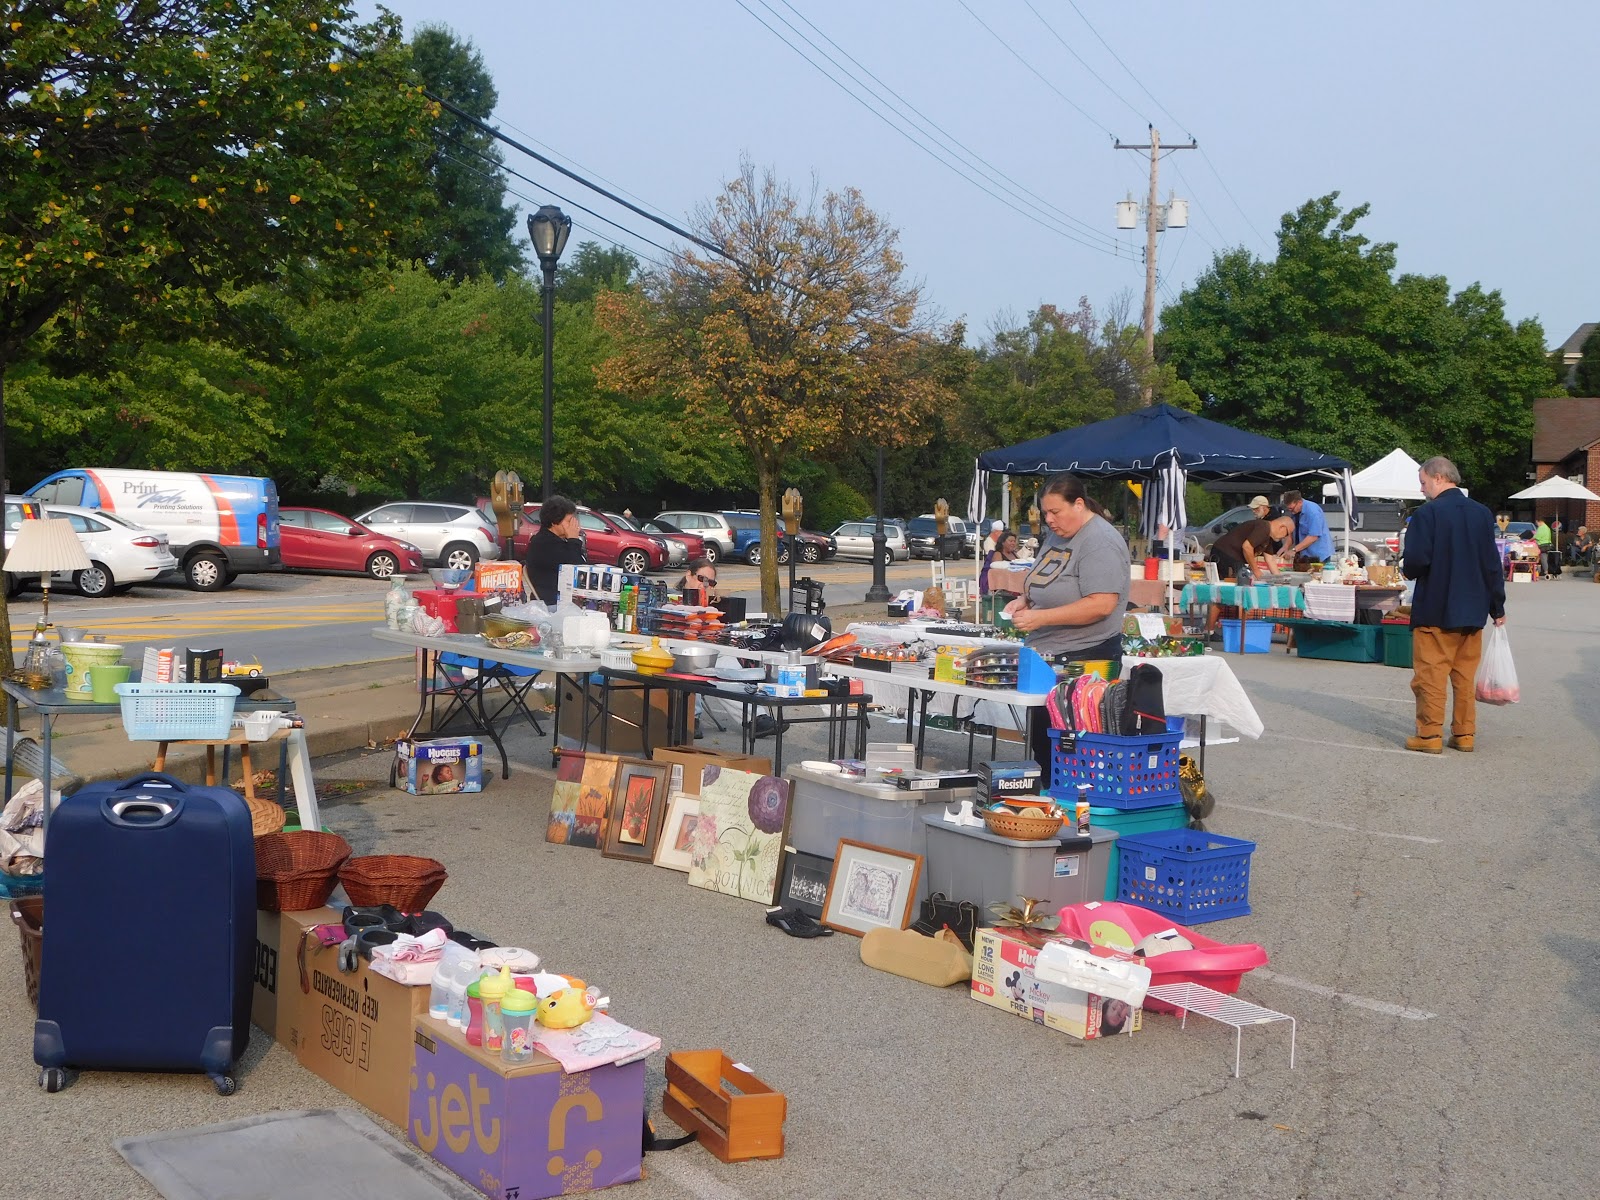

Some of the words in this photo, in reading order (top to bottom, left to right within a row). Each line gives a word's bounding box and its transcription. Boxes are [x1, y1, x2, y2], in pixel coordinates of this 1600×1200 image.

[122, 481, 158, 494] Print
[153, 503, 176, 511] Printing
[176, 503, 203, 511] Solutions
[480, 570, 520, 589] WHEATIES
[998, 778, 1034, 790] ResistAll
[982, 945, 994, 959] 12
[977, 962, 995, 974] LONG
[312, 968, 360, 1014] REFRIGERATED
[361, 993, 379, 1023] KEEP
[1010, 1000, 1029, 1015] FREE
[1087, 994, 1098, 1037] HUGGIES
[320, 1003, 372, 1073] EGGS
